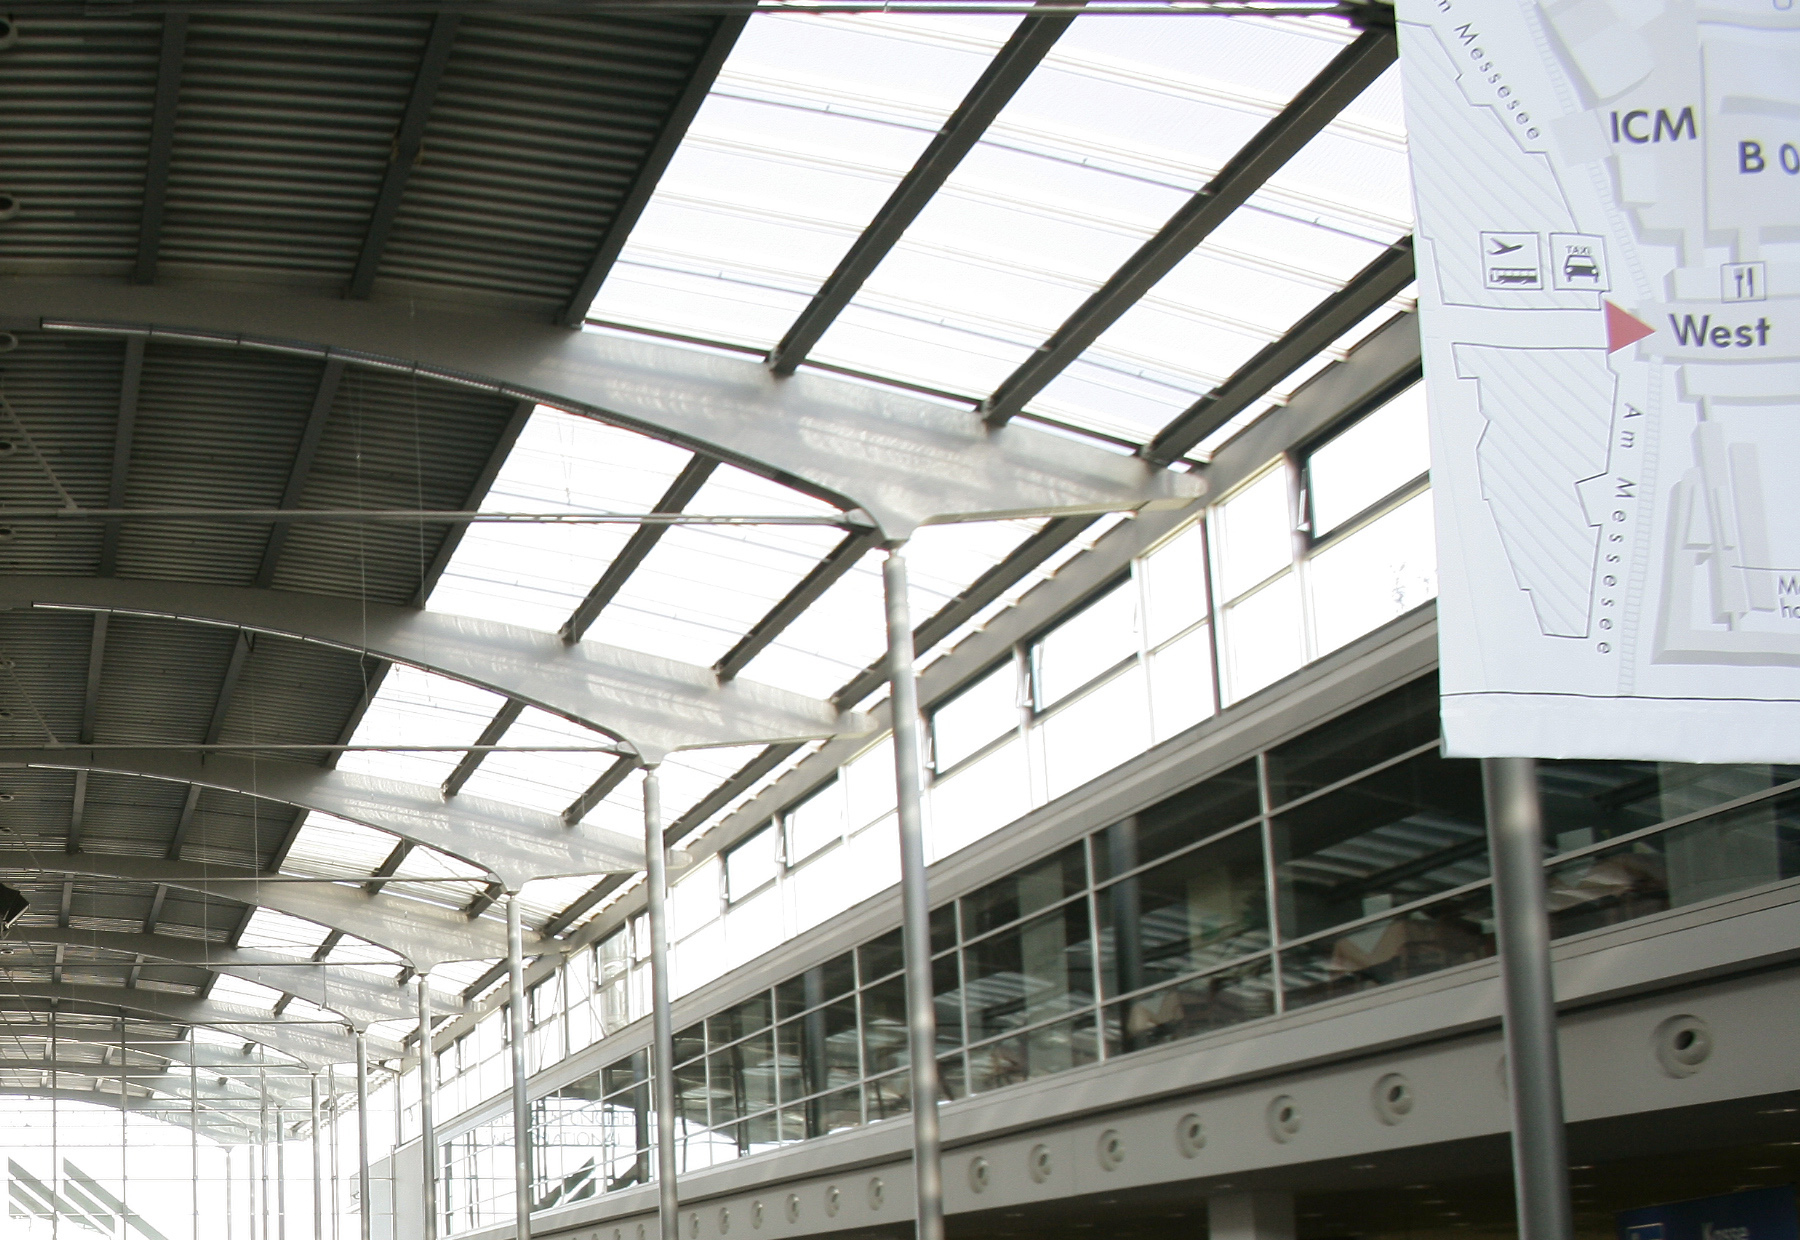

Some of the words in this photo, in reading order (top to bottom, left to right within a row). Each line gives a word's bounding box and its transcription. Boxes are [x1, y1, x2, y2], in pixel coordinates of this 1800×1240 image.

[1453, 23, 1540, 141] Messesee
[1610, 107, 1697, 143] ICM
[1738, 142, 1766, 175] B
[1565, 246, 1592, 255] TAXI
[1669, 313, 1771, 349] West
[1620, 403, 1644, 449] Am
[1597, 478, 1636, 655] Messesee
